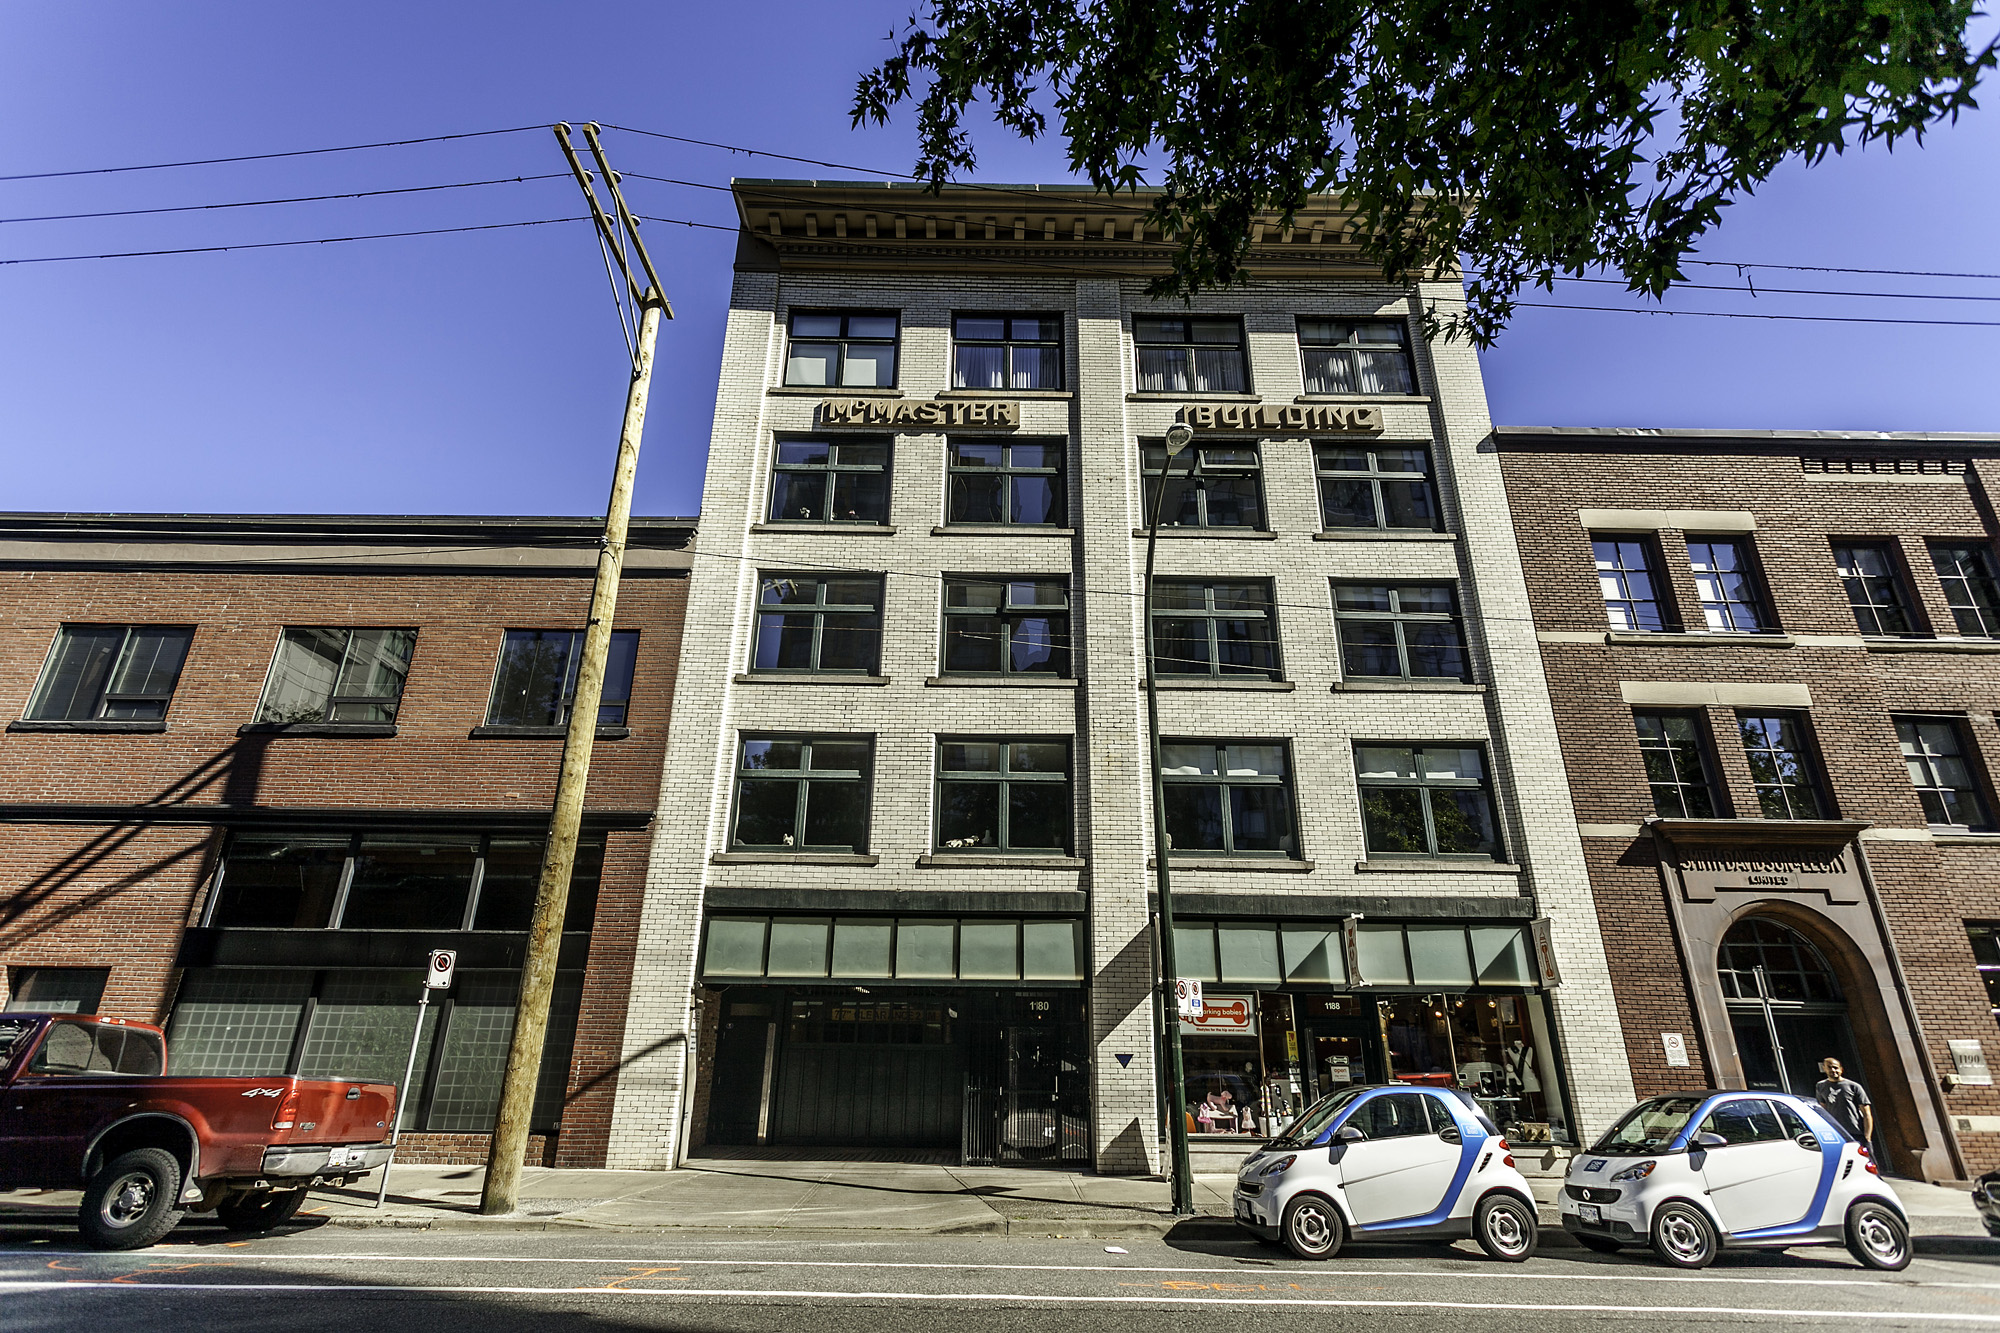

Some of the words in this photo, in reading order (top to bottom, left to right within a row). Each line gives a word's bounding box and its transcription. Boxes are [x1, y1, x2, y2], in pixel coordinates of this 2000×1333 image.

[1194, 404, 1375, 427] BUILDING
[1747, 875, 1789, 886] LIMITED
[1029, 1001, 1049, 1011] 1180
[1324, 1002, 1341, 1010] 1188
[1203, 1009, 1221, 1017] arking
[1959, 1054, 1980, 1064] 1190
